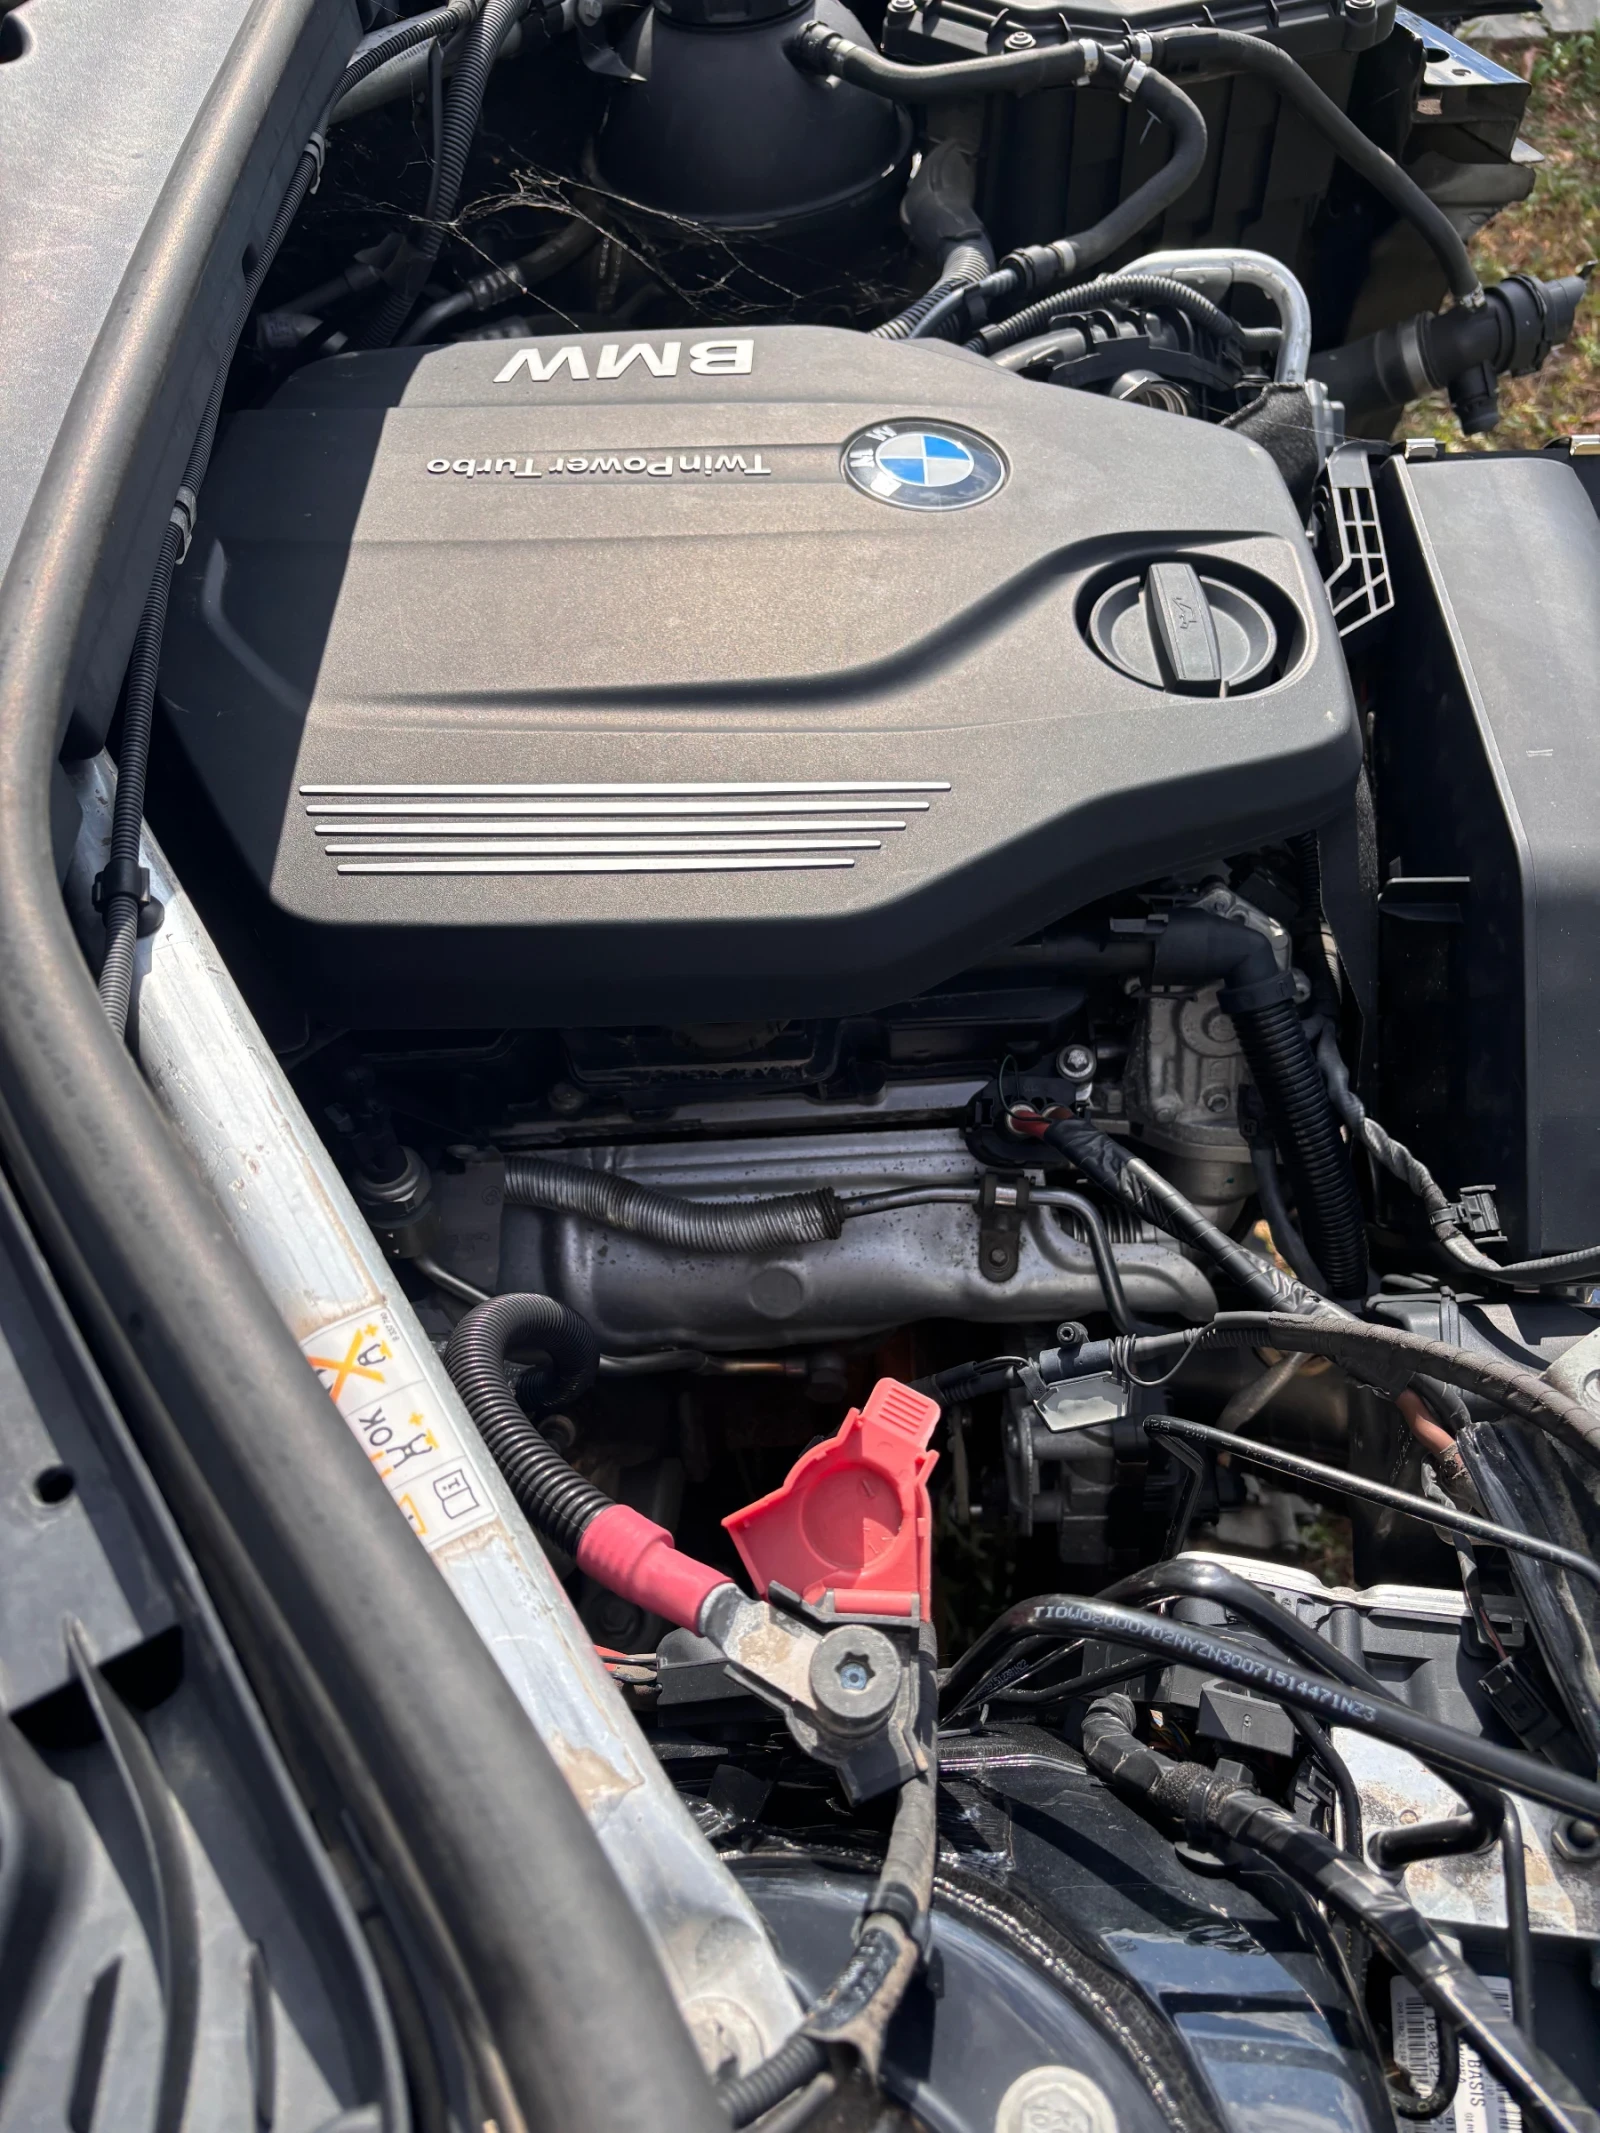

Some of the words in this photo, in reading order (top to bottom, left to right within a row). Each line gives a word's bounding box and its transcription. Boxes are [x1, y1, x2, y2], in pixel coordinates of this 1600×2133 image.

[493, 339, 755, 384] BMW
[426, 456, 542, 478] Turbo
[358, 1405, 393, 1447] OK
[1467, 2059, 1487, 2107] BASIS
